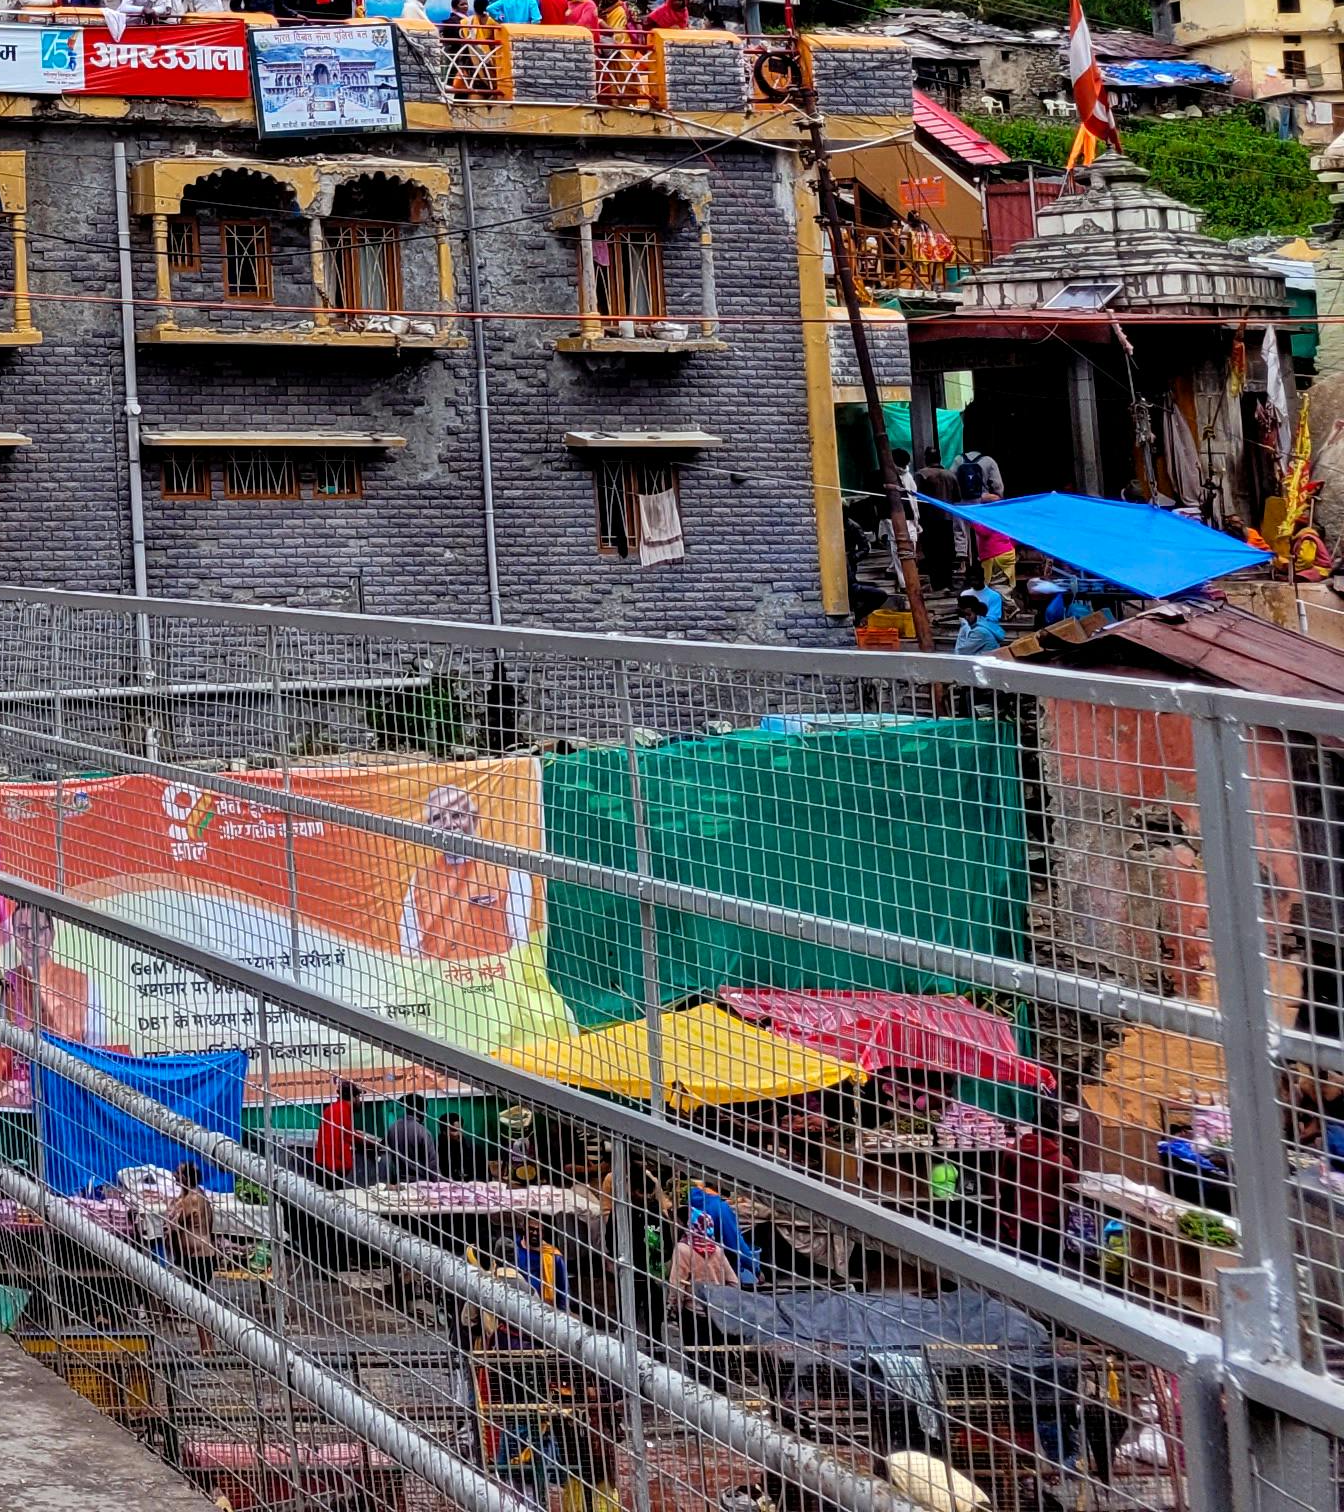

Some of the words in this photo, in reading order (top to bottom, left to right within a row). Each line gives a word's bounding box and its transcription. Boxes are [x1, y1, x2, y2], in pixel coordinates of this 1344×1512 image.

[90, 42, 158, 68] अमर
[159, 44, 244, 71] उजाला
[131, 961, 168, 976] GeM
[138, 1015, 169, 1031] DBT
